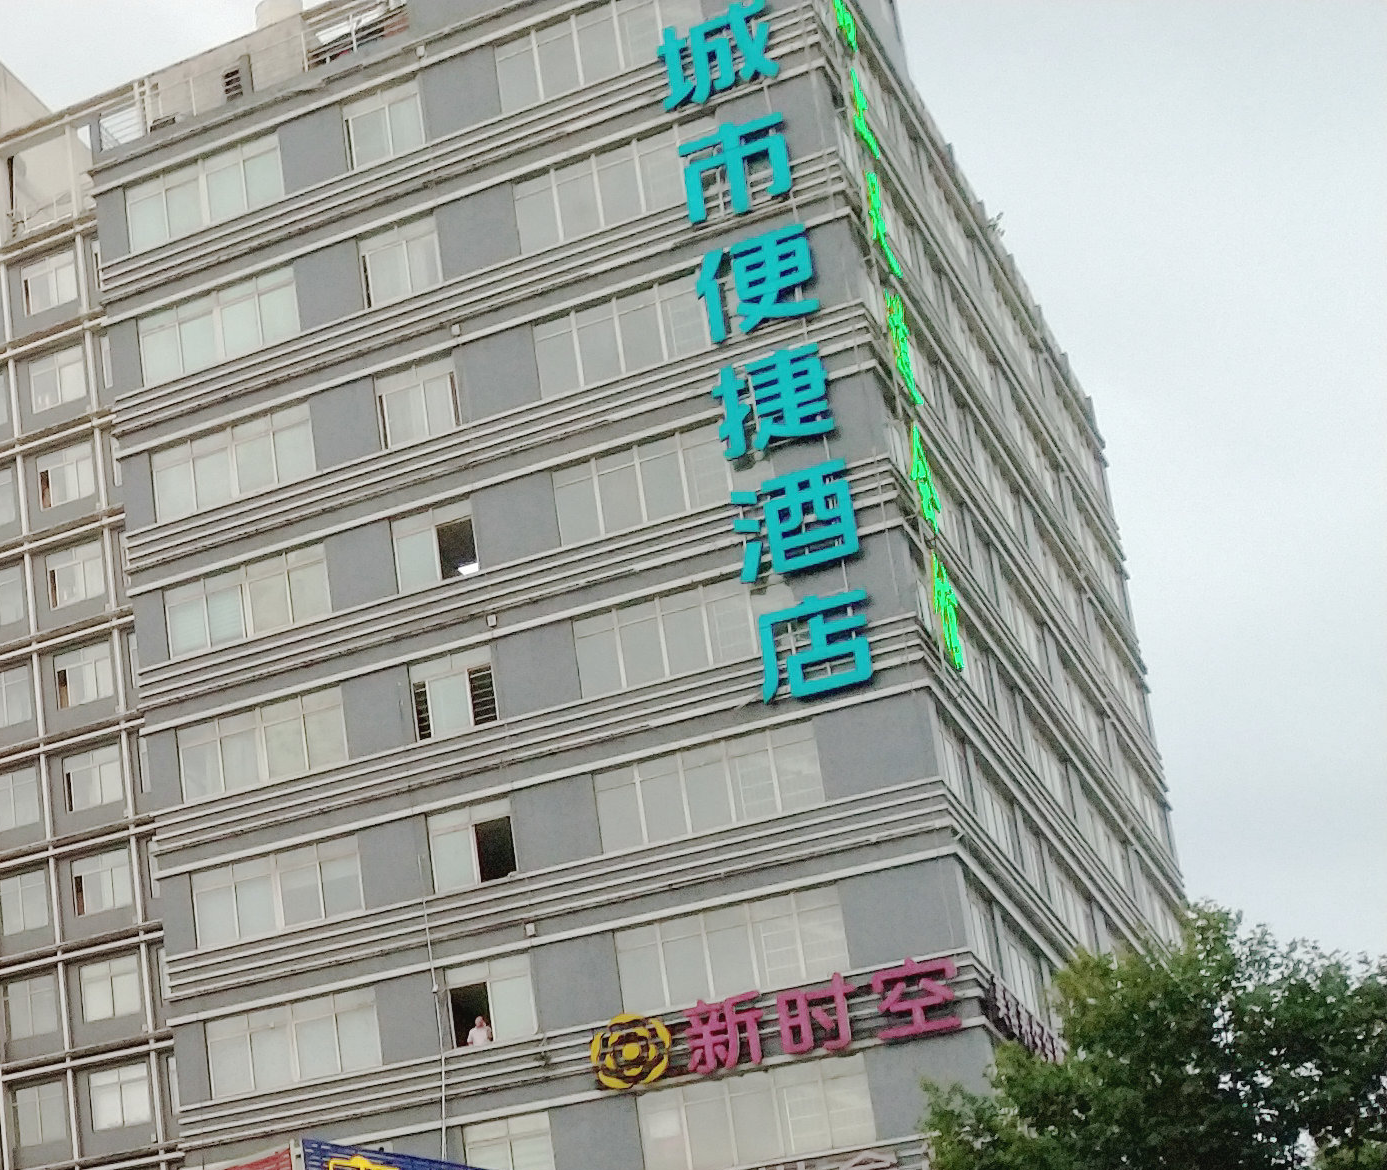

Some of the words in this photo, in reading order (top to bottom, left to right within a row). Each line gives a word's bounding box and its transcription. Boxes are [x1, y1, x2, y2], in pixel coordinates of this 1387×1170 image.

[656, 0, 875, 704] 城市便捷酒店
[681, 957, 963, 1074] 新时空
